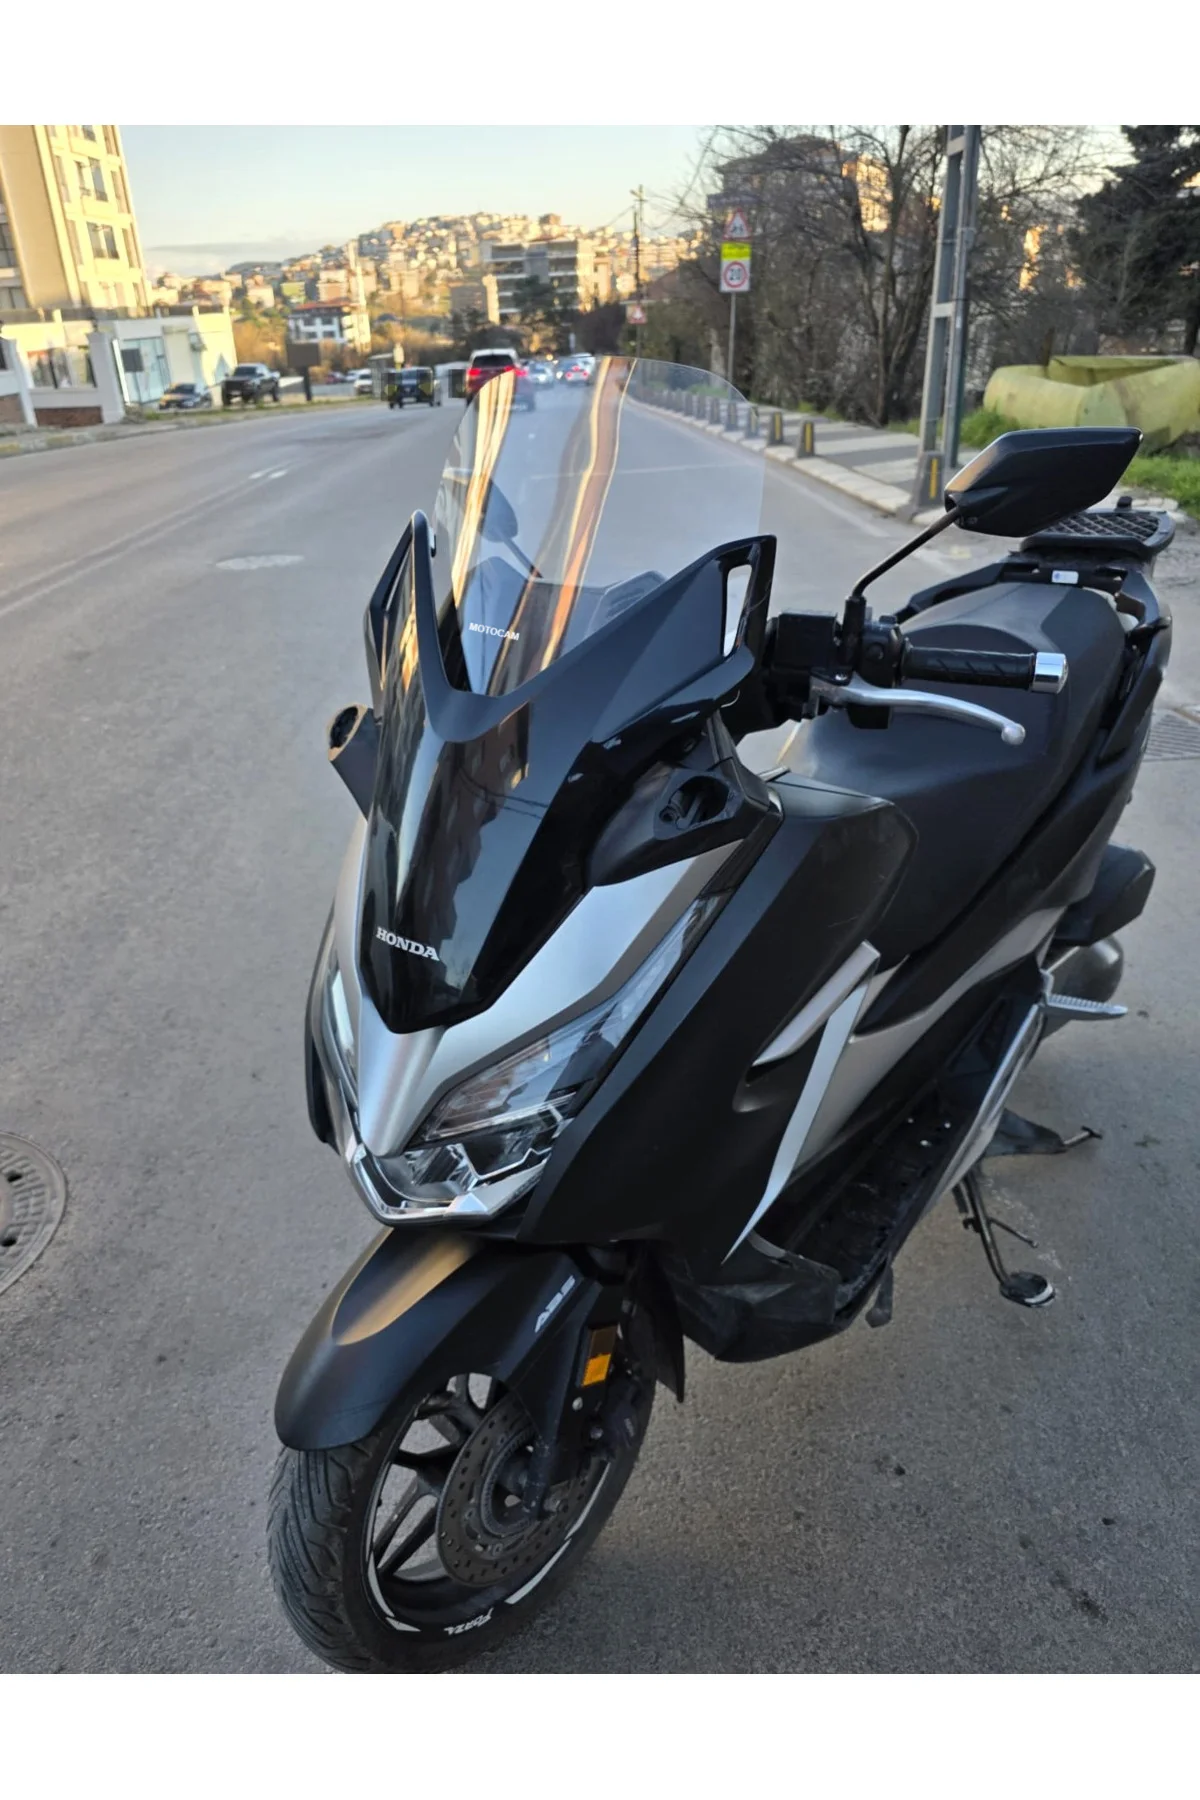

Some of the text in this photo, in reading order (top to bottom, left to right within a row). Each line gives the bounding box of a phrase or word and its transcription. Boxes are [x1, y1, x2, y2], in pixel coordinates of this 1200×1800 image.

[468, 622, 520, 641] MOTOCAM
[375, 926, 440, 962] HONDA
[534, 1274, 576, 1333] ABS
